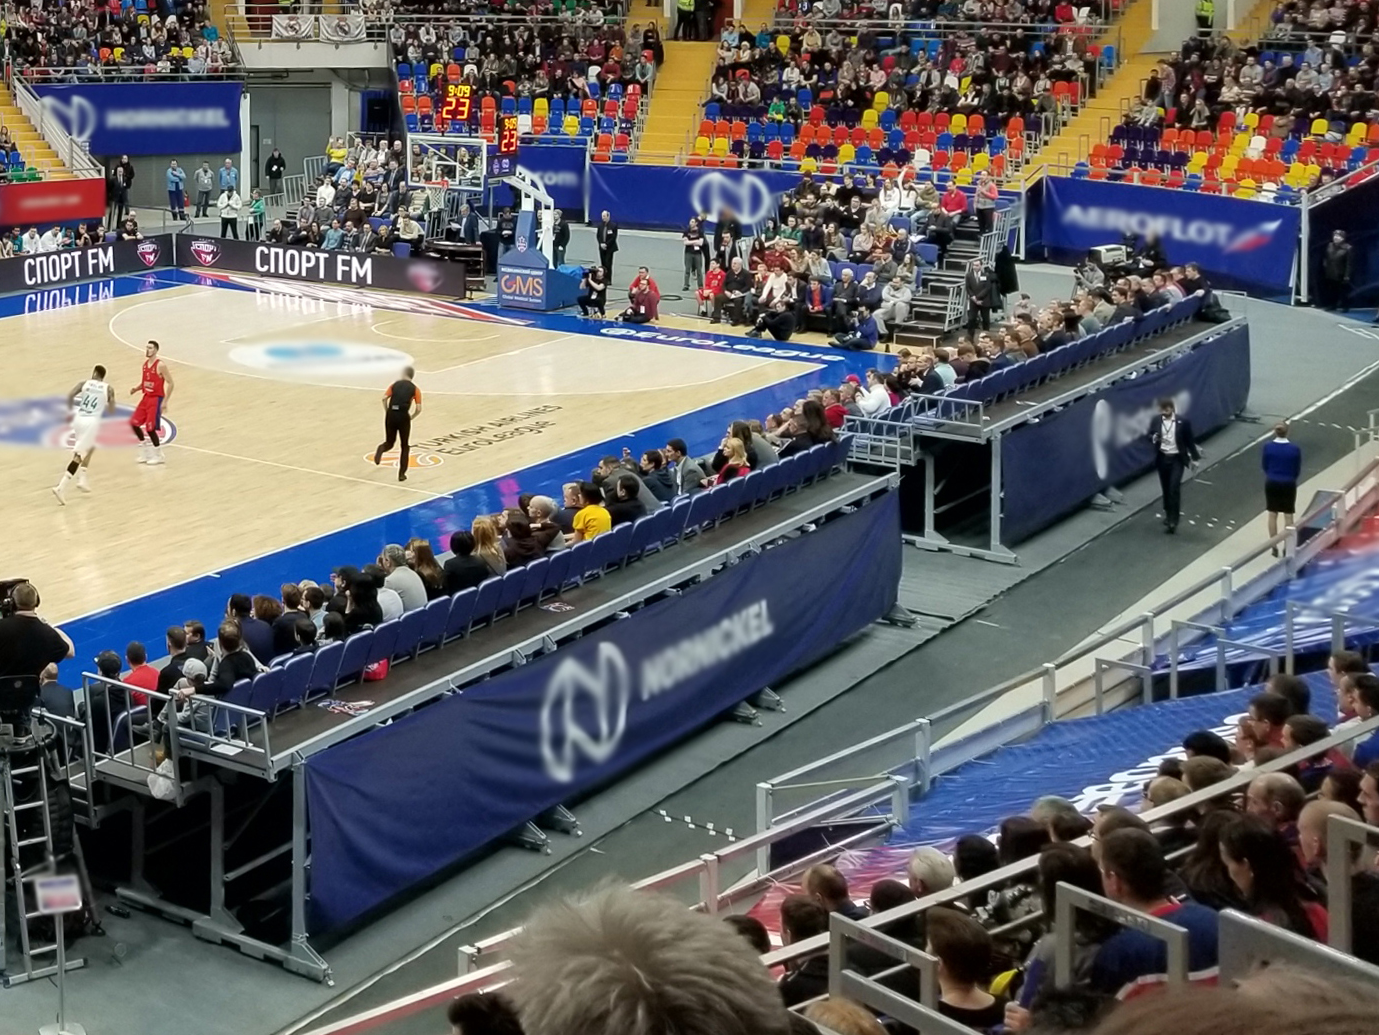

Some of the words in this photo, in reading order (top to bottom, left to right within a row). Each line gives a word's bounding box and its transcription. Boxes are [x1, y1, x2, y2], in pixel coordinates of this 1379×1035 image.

[448, 85, 471, 98] 9:09
[442, 98, 470, 120] 23
[501, 131, 518, 153] 23
[23, 250, 82, 286] СПОРТ
[87, 245, 115, 275] FM
[255, 245, 329, 280] СПОРТ
[336, 254, 373, 285] FM
[83, 395, 98, 410] 44
[408, 425, 490, 452] TURKISH
[489, 404, 564, 430] AIRLINES
